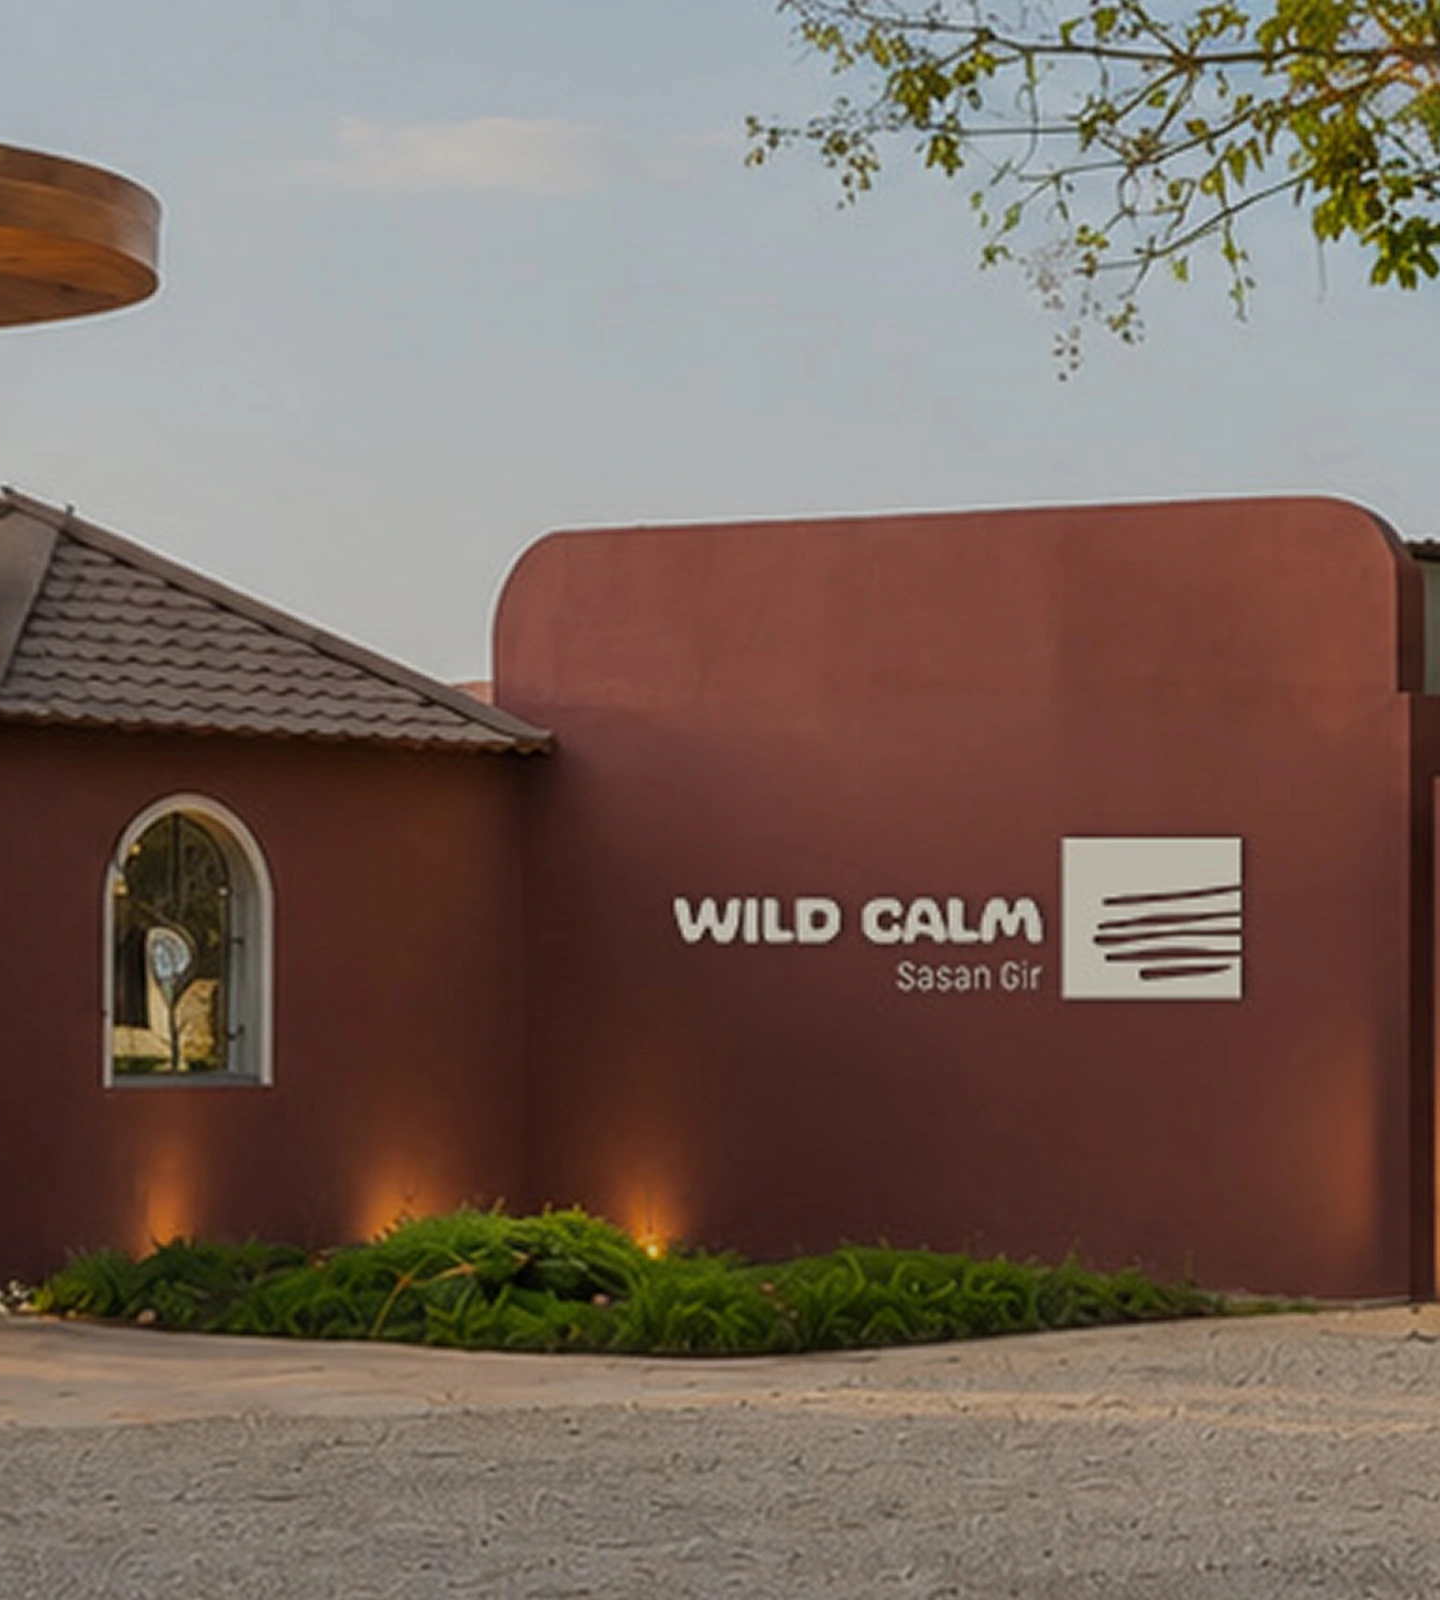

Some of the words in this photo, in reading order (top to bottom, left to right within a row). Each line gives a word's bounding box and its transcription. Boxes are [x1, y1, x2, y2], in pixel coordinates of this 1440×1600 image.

[674, 897, 841, 944] WILD
[861, 897, 1043, 945] CALM
[896, 961, 992, 991] Sasan
[1000, 960, 1042, 991] Gir
